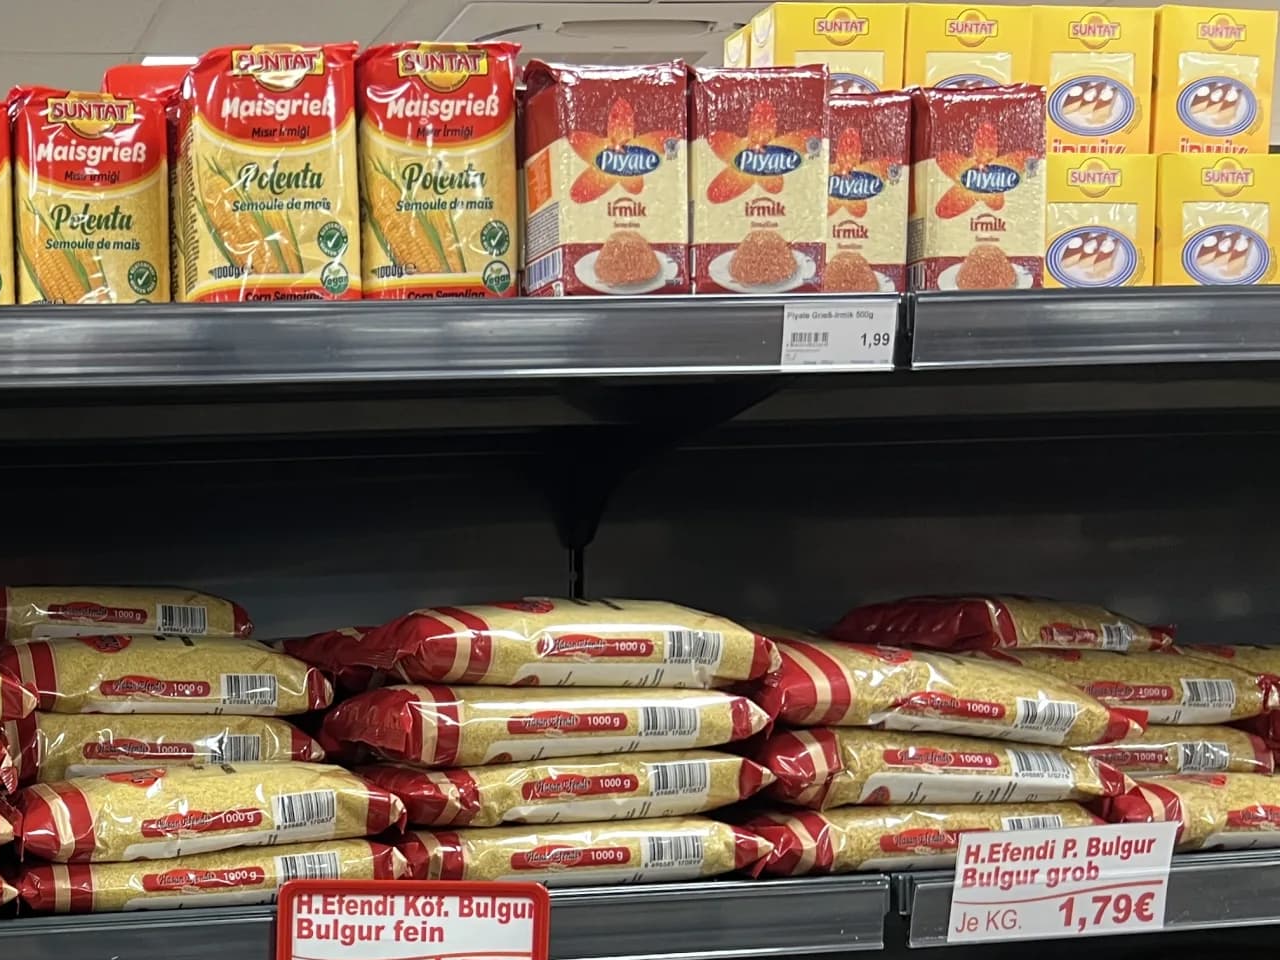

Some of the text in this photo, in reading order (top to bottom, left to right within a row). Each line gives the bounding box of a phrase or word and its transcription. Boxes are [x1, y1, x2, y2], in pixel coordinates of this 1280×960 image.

[816, 18, 866, 33] SUNTAT
[948, 20, 996, 36] SUNTAT
[1073, 23, 1117, 38] SUNTAT
[1200, 24, 1243, 38] SUNTAT
[403, 52, 481, 74] SUNTAT
[53, 101, 129, 121] SUNTAT
[386, 95, 499, 119] Maisgrieß
[37, 141, 146, 168] Maisgrieß
[601, 149, 658, 174] Piyale
[739, 149, 798, 174] Piyale
[402, 162, 486, 195] Polenta
[965, 167, 1018, 191] Piyale
[1071, 170, 1117, 184] SUNTAT
[1205, 170, 1250, 184] SUNTAT
[51, 204, 133, 235] Polenta
[608, 202, 646, 217] irmik
[745, 202, 786, 217] irmik
[970, 218, 1006, 233] irmik
[861, 333, 890, 348] 1,99
[173, 683, 203, 695] 1000 g
[587, 716, 620, 728] 1000 g
[959, 754, 992, 767] 1000 g
[591, 850, 623, 861] 1000 g
[964, 836, 1156, 864] H.Efendi P. Bulgur
[962, 862, 1099, 890] Bulgur grob
[296, 894, 395, 916] H.Efendi
[1058, 892, 1155, 932] 1,79€
[955, 909, 1022, 933] Je KG.
[296, 918, 444, 946] Bulgur fein
